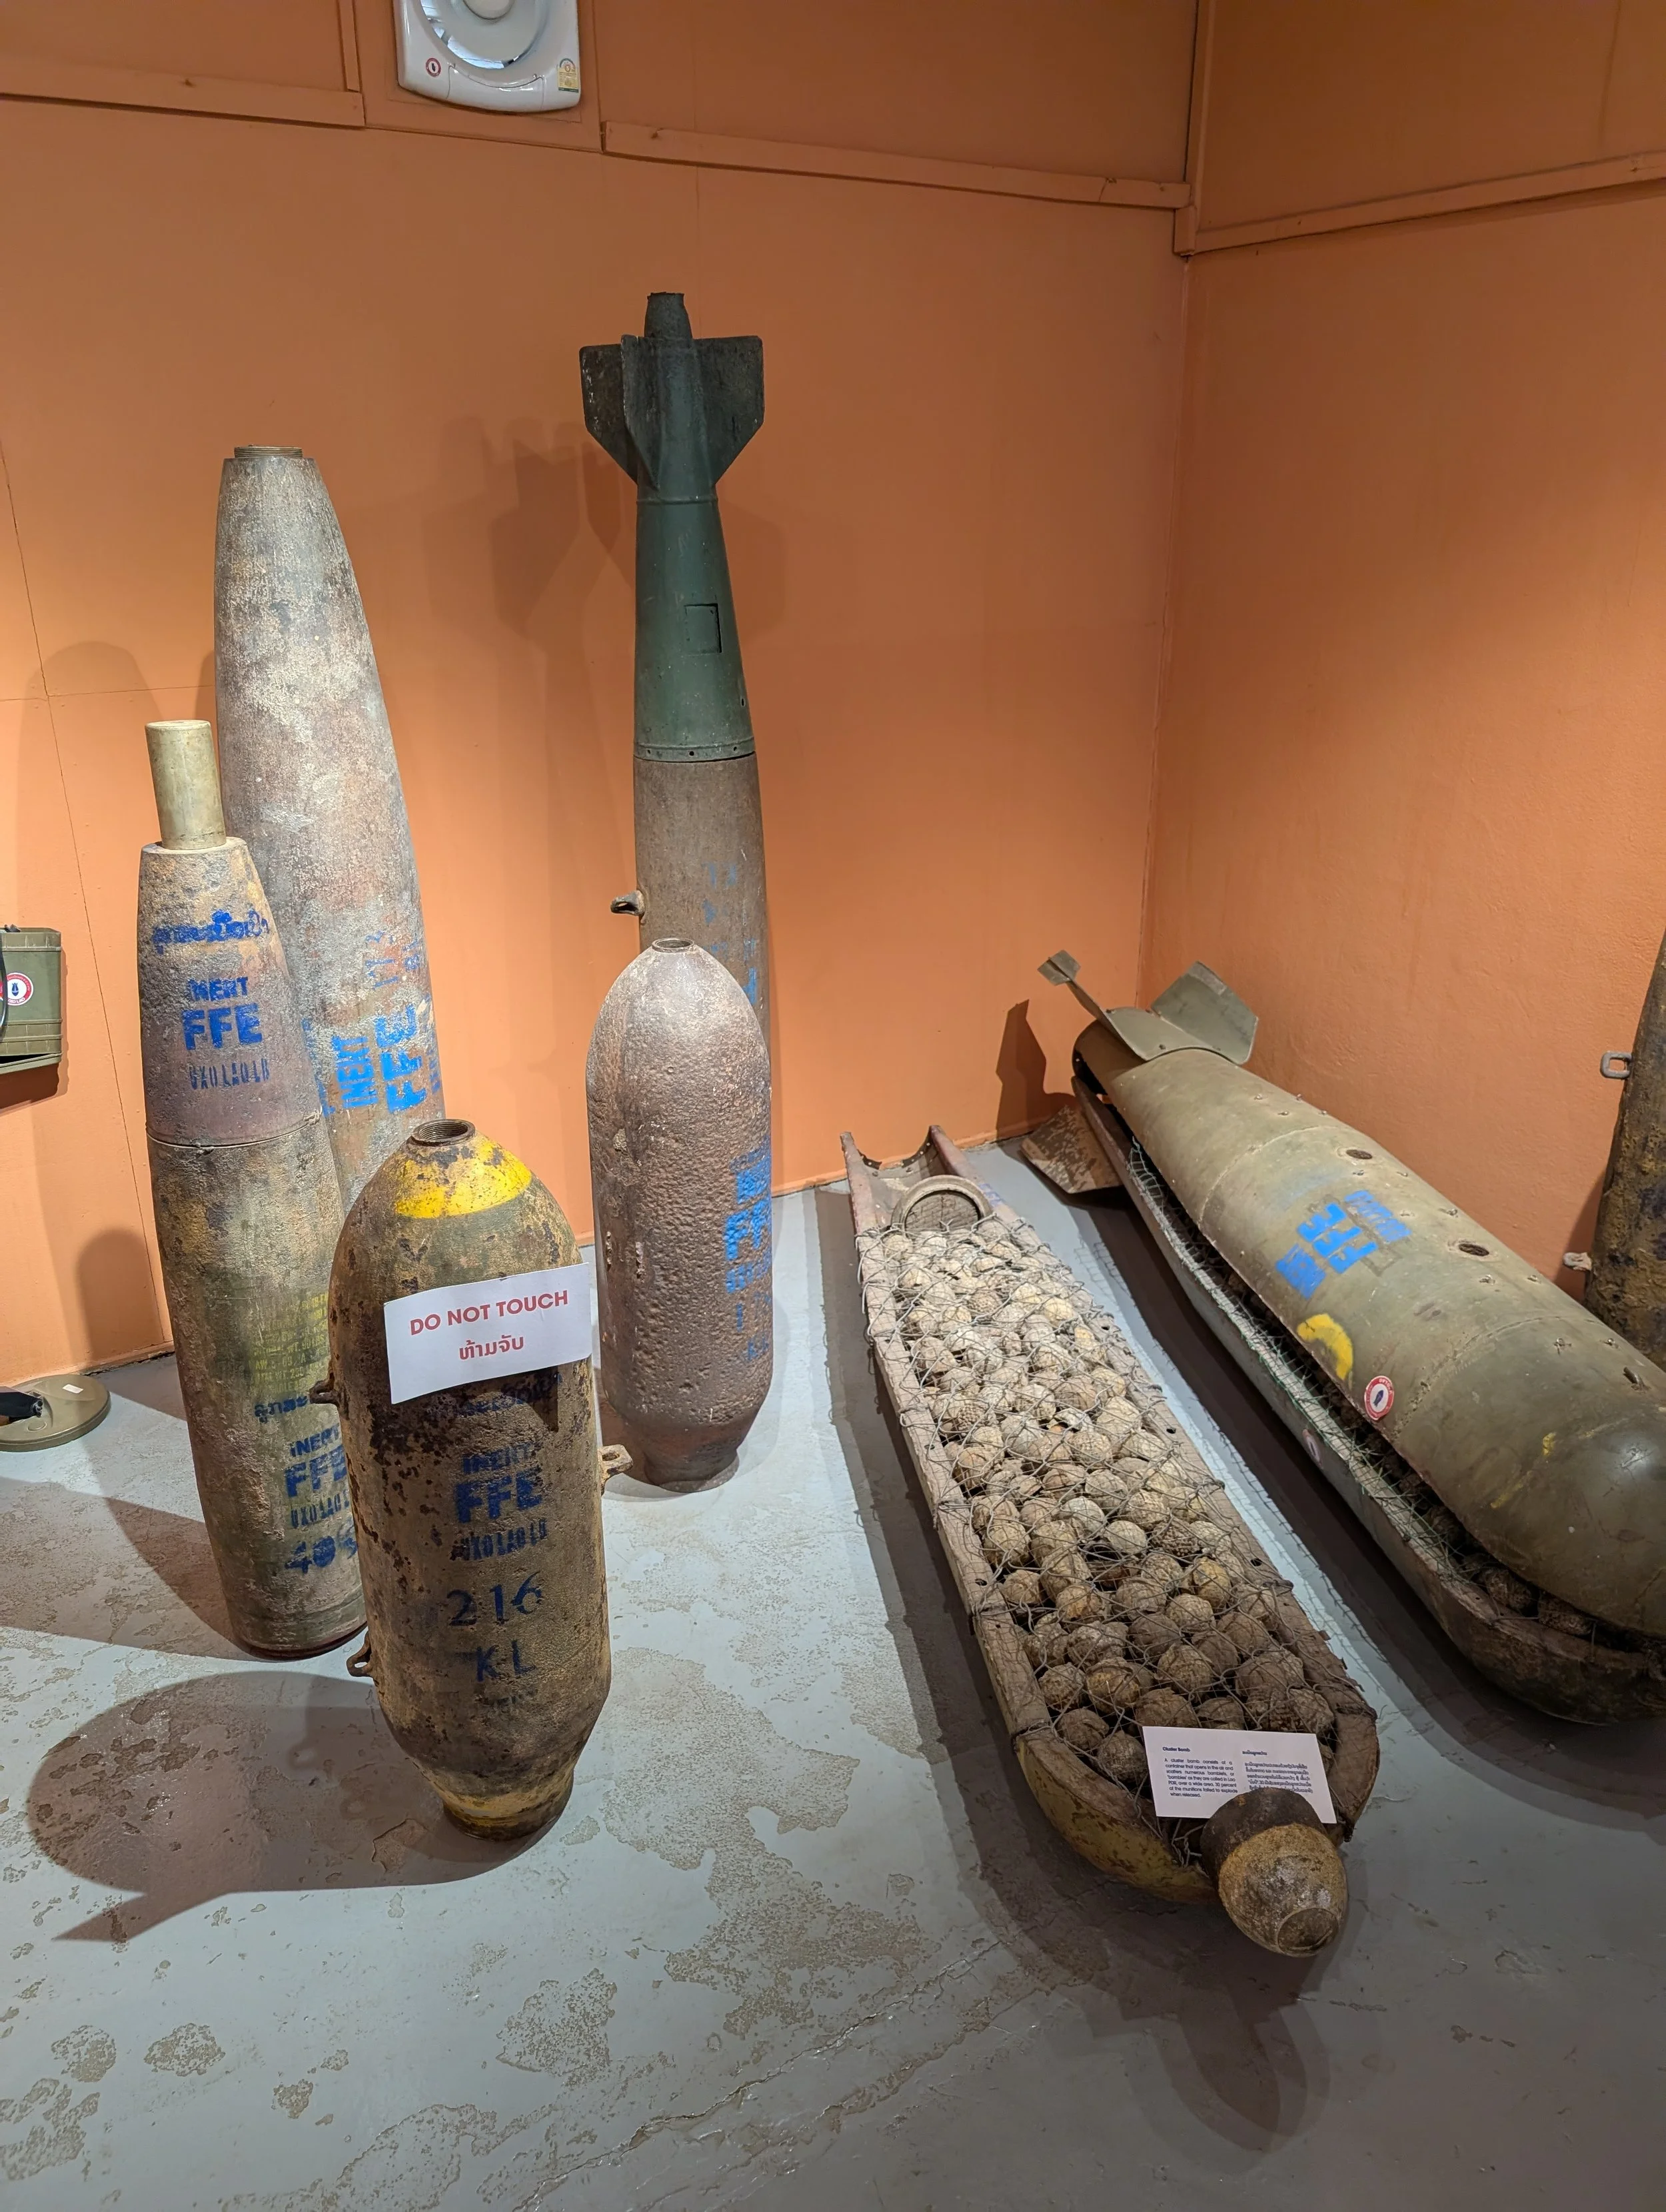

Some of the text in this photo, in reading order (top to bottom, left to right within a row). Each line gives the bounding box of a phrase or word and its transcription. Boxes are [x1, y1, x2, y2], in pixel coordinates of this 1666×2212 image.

[181, 1003, 263, 1051] FFE
[1297, 1203, 1378, 1275] FFE
[411, 1290, 568, 1335] DO NOT TOUCH
[290, 1422, 340, 1458] INERT
[454, 1467, 542, 1524] FFE
[447, 1570, 544, 1626] 216
